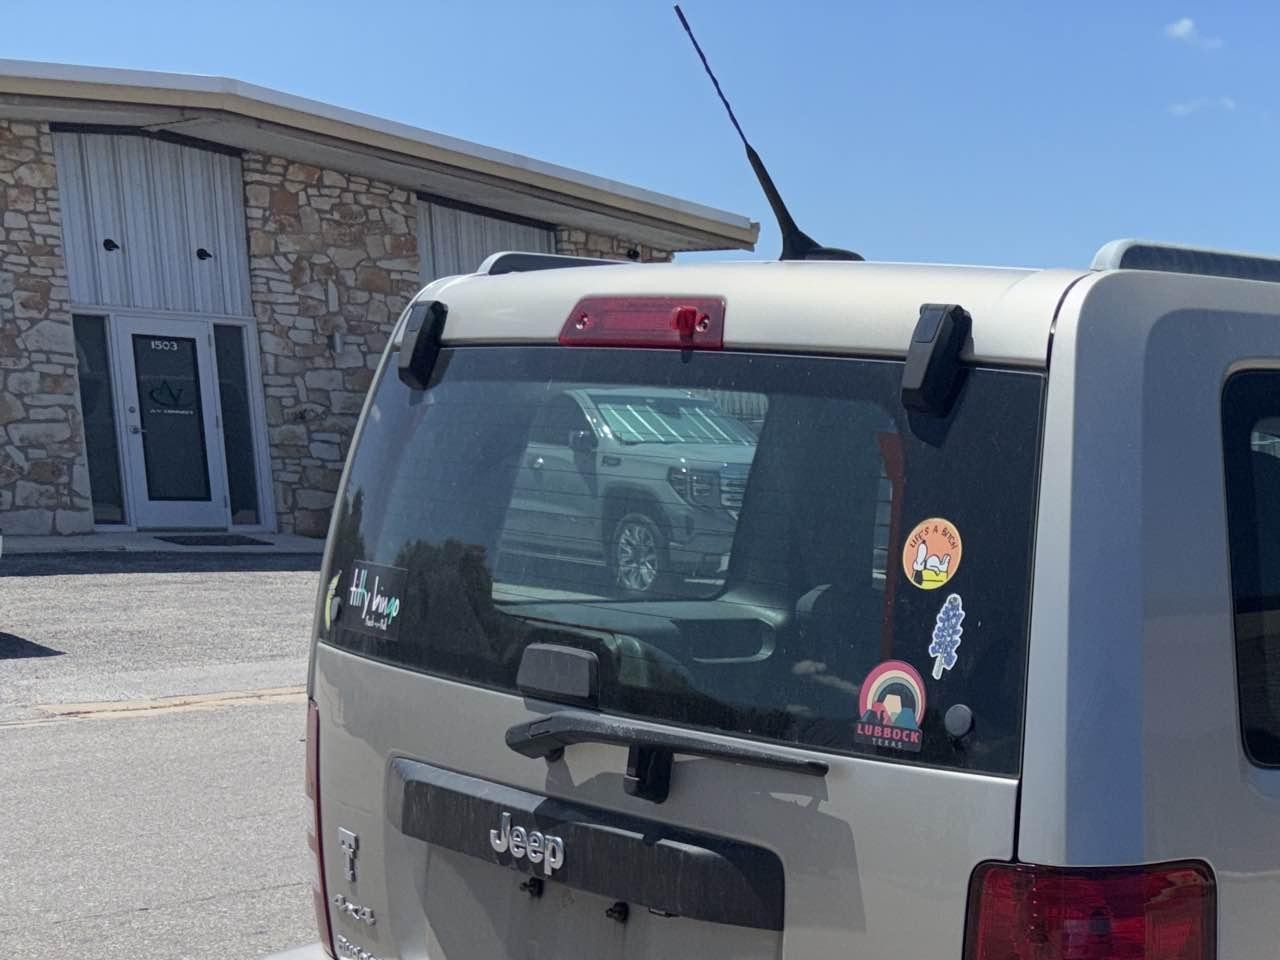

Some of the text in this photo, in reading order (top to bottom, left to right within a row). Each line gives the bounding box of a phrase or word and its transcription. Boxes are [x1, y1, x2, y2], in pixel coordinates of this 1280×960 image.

[151, 341, 178, 351] 1503
[933, 524, 939, 535] A
[941, 526, 959, 550] BITCH
[372, 575, 400, 625] bingo
[856, 723, 920, 743] LUBBOCK
[872, 737, 902, 749] TEXAS
[489, 811, 565, 876] Jeep
